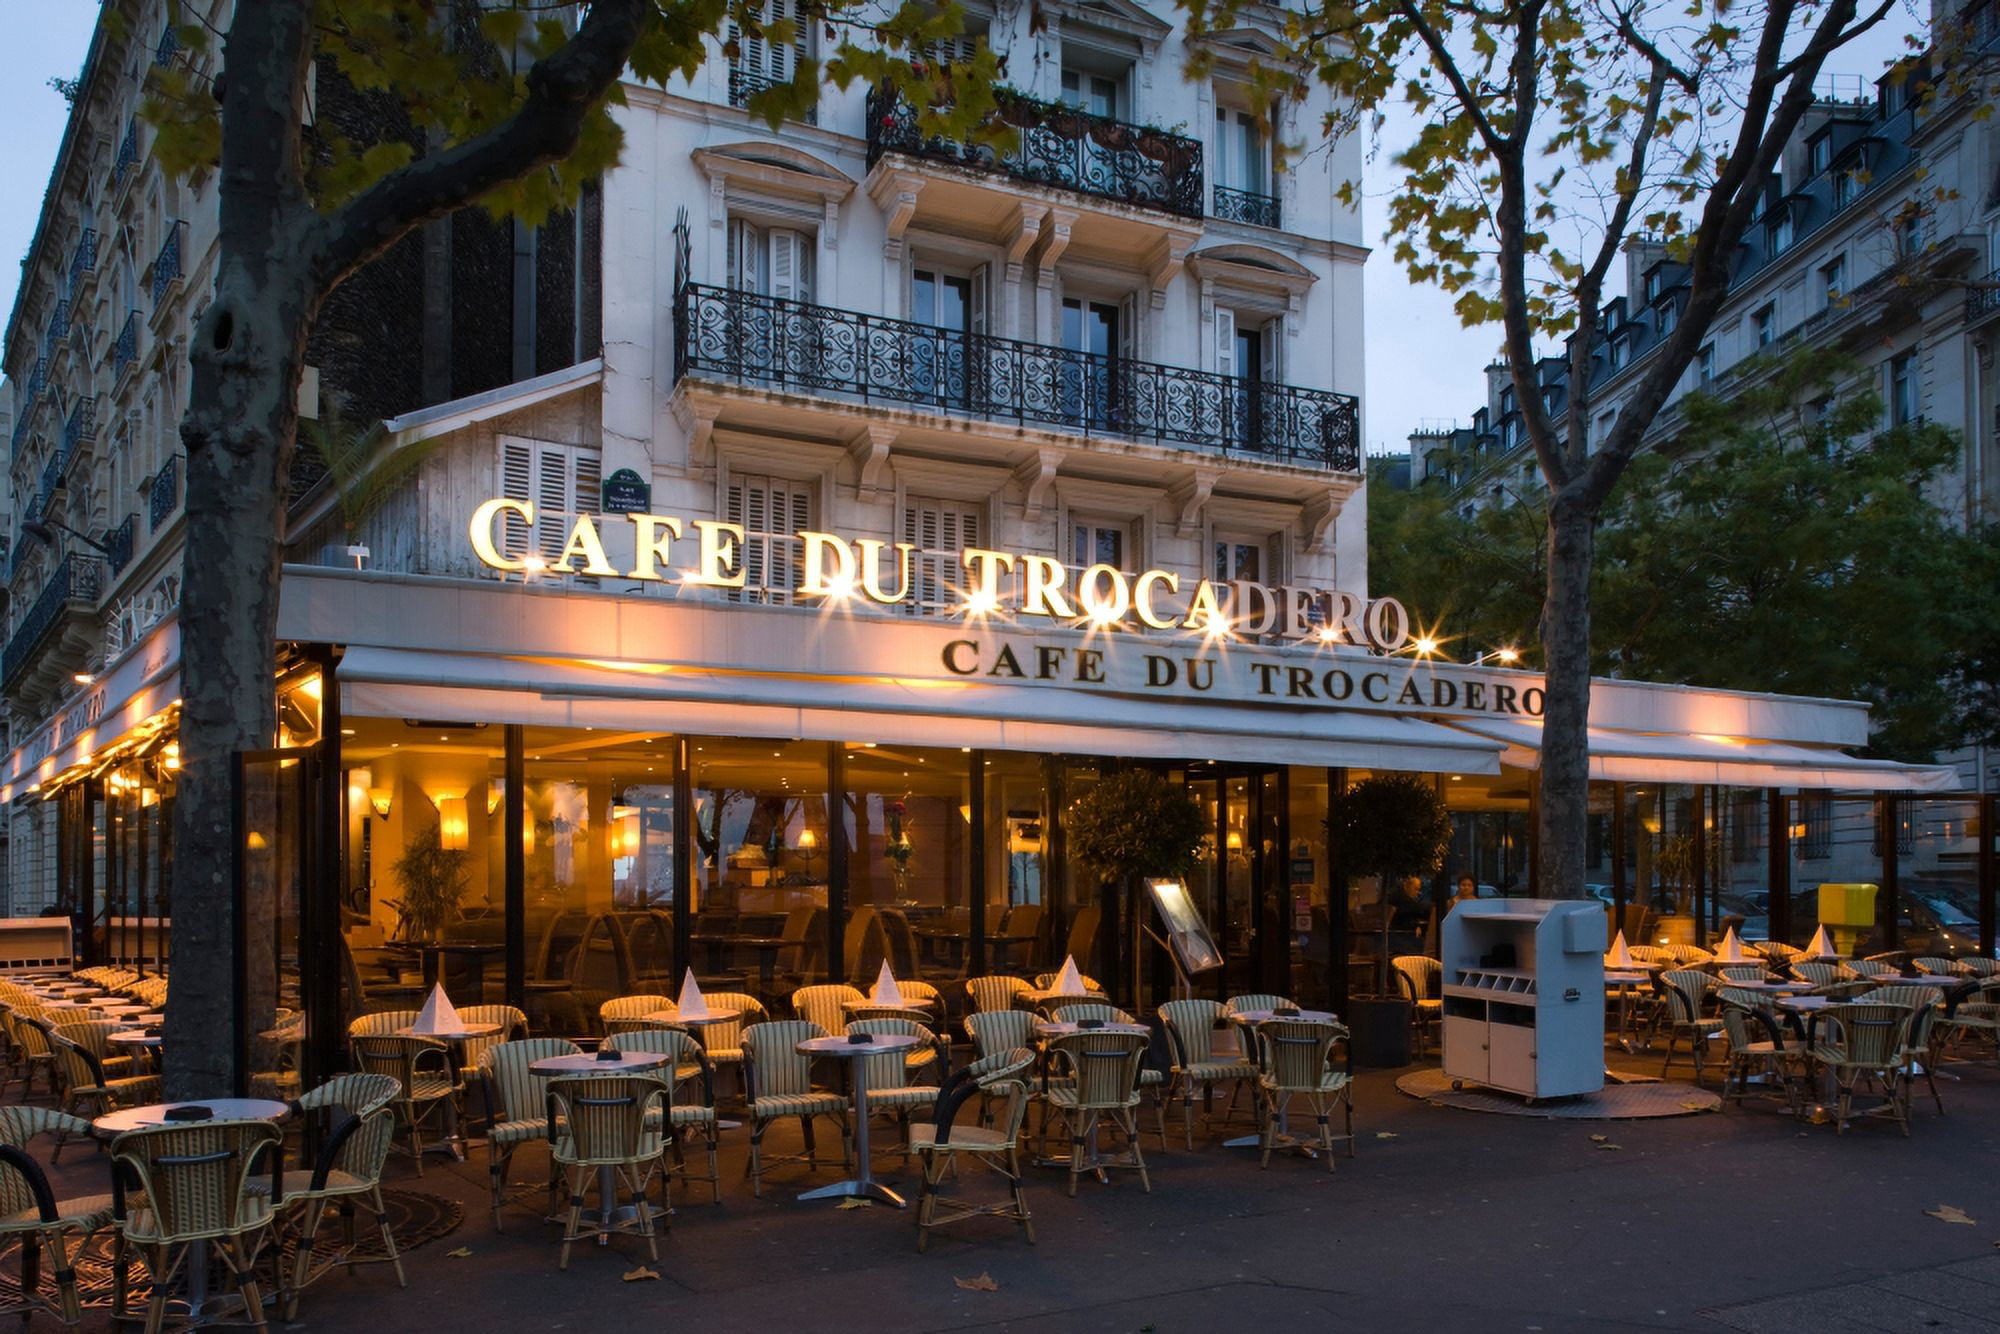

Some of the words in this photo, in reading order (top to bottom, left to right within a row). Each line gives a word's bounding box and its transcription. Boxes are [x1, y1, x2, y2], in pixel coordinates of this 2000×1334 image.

[468, 498, 746, 588] CAFE
[797, 531, 916, 603] DU
[961, 547, 1409, 651] TROCADERO
[941, 639, 1106, 684] CAFE
[1144, 654, 1217, 691] DU
[1250, 663, 1546, 717] TROCADERO
